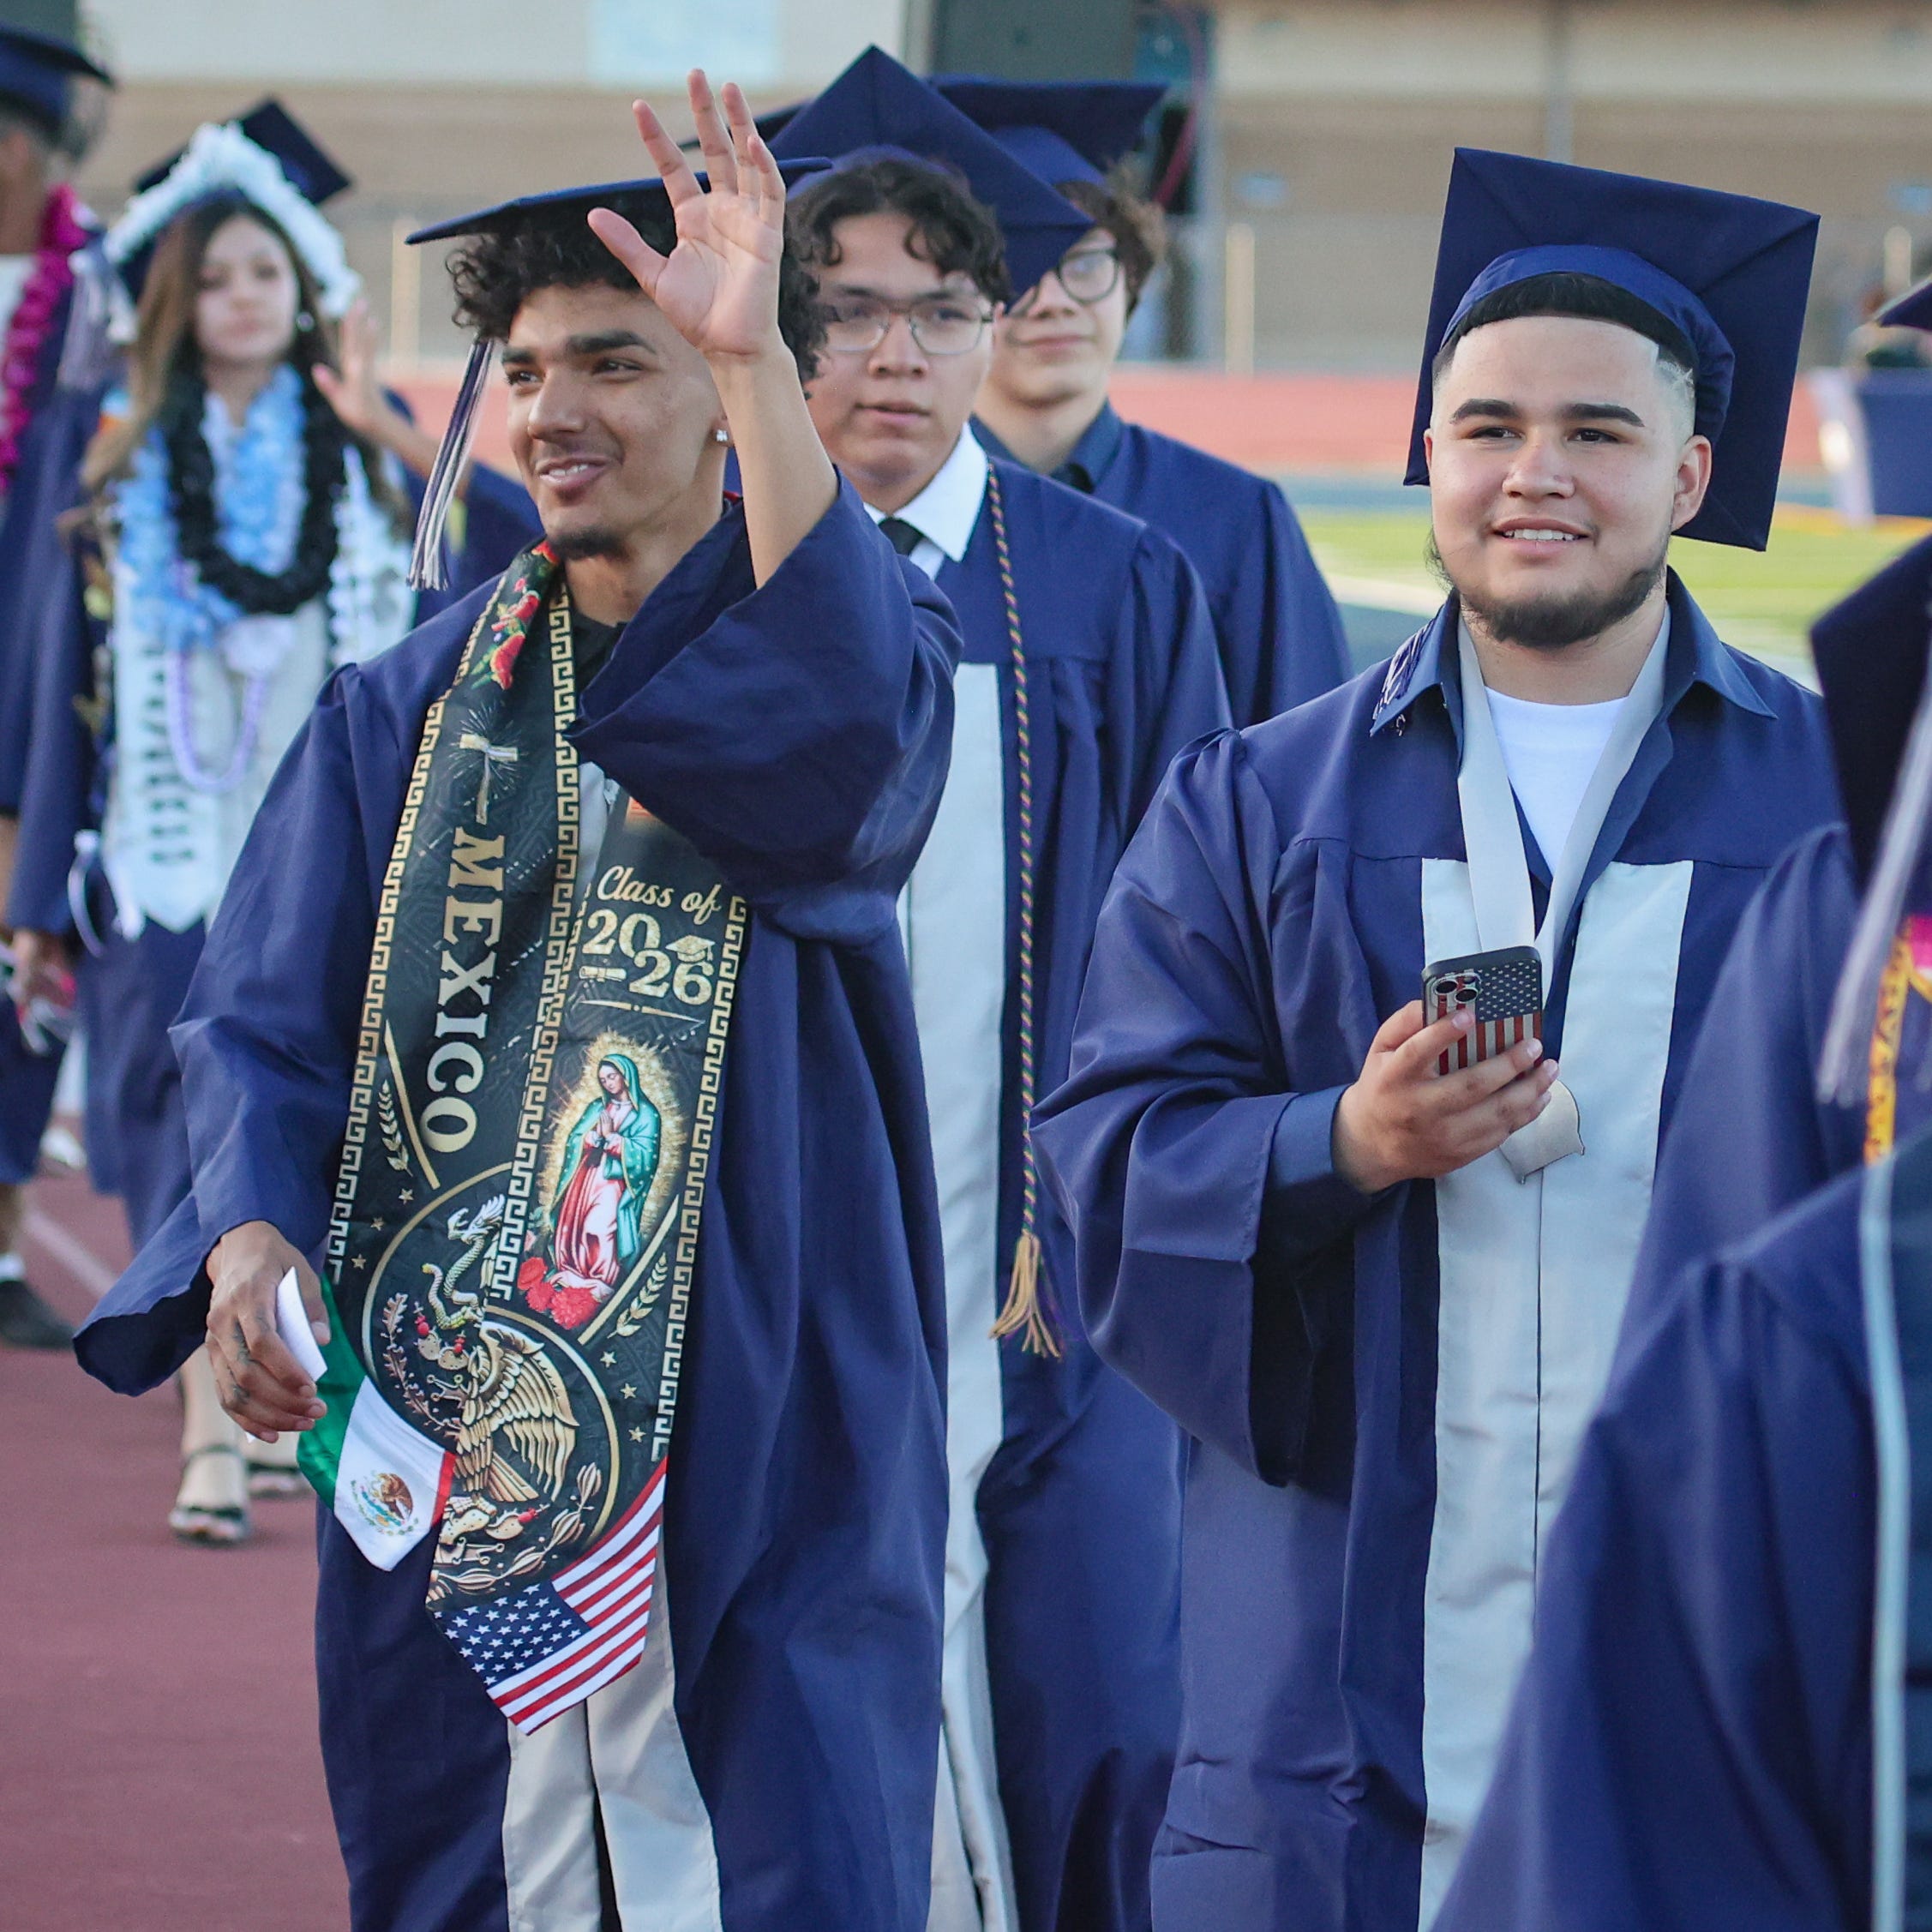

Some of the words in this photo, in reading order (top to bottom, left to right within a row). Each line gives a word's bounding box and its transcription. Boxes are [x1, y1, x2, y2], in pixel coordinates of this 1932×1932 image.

[420, 826, 506, 1153] MEXICO
[597, 865, 674, 908] Class
[681, 884, 722, 925] of
